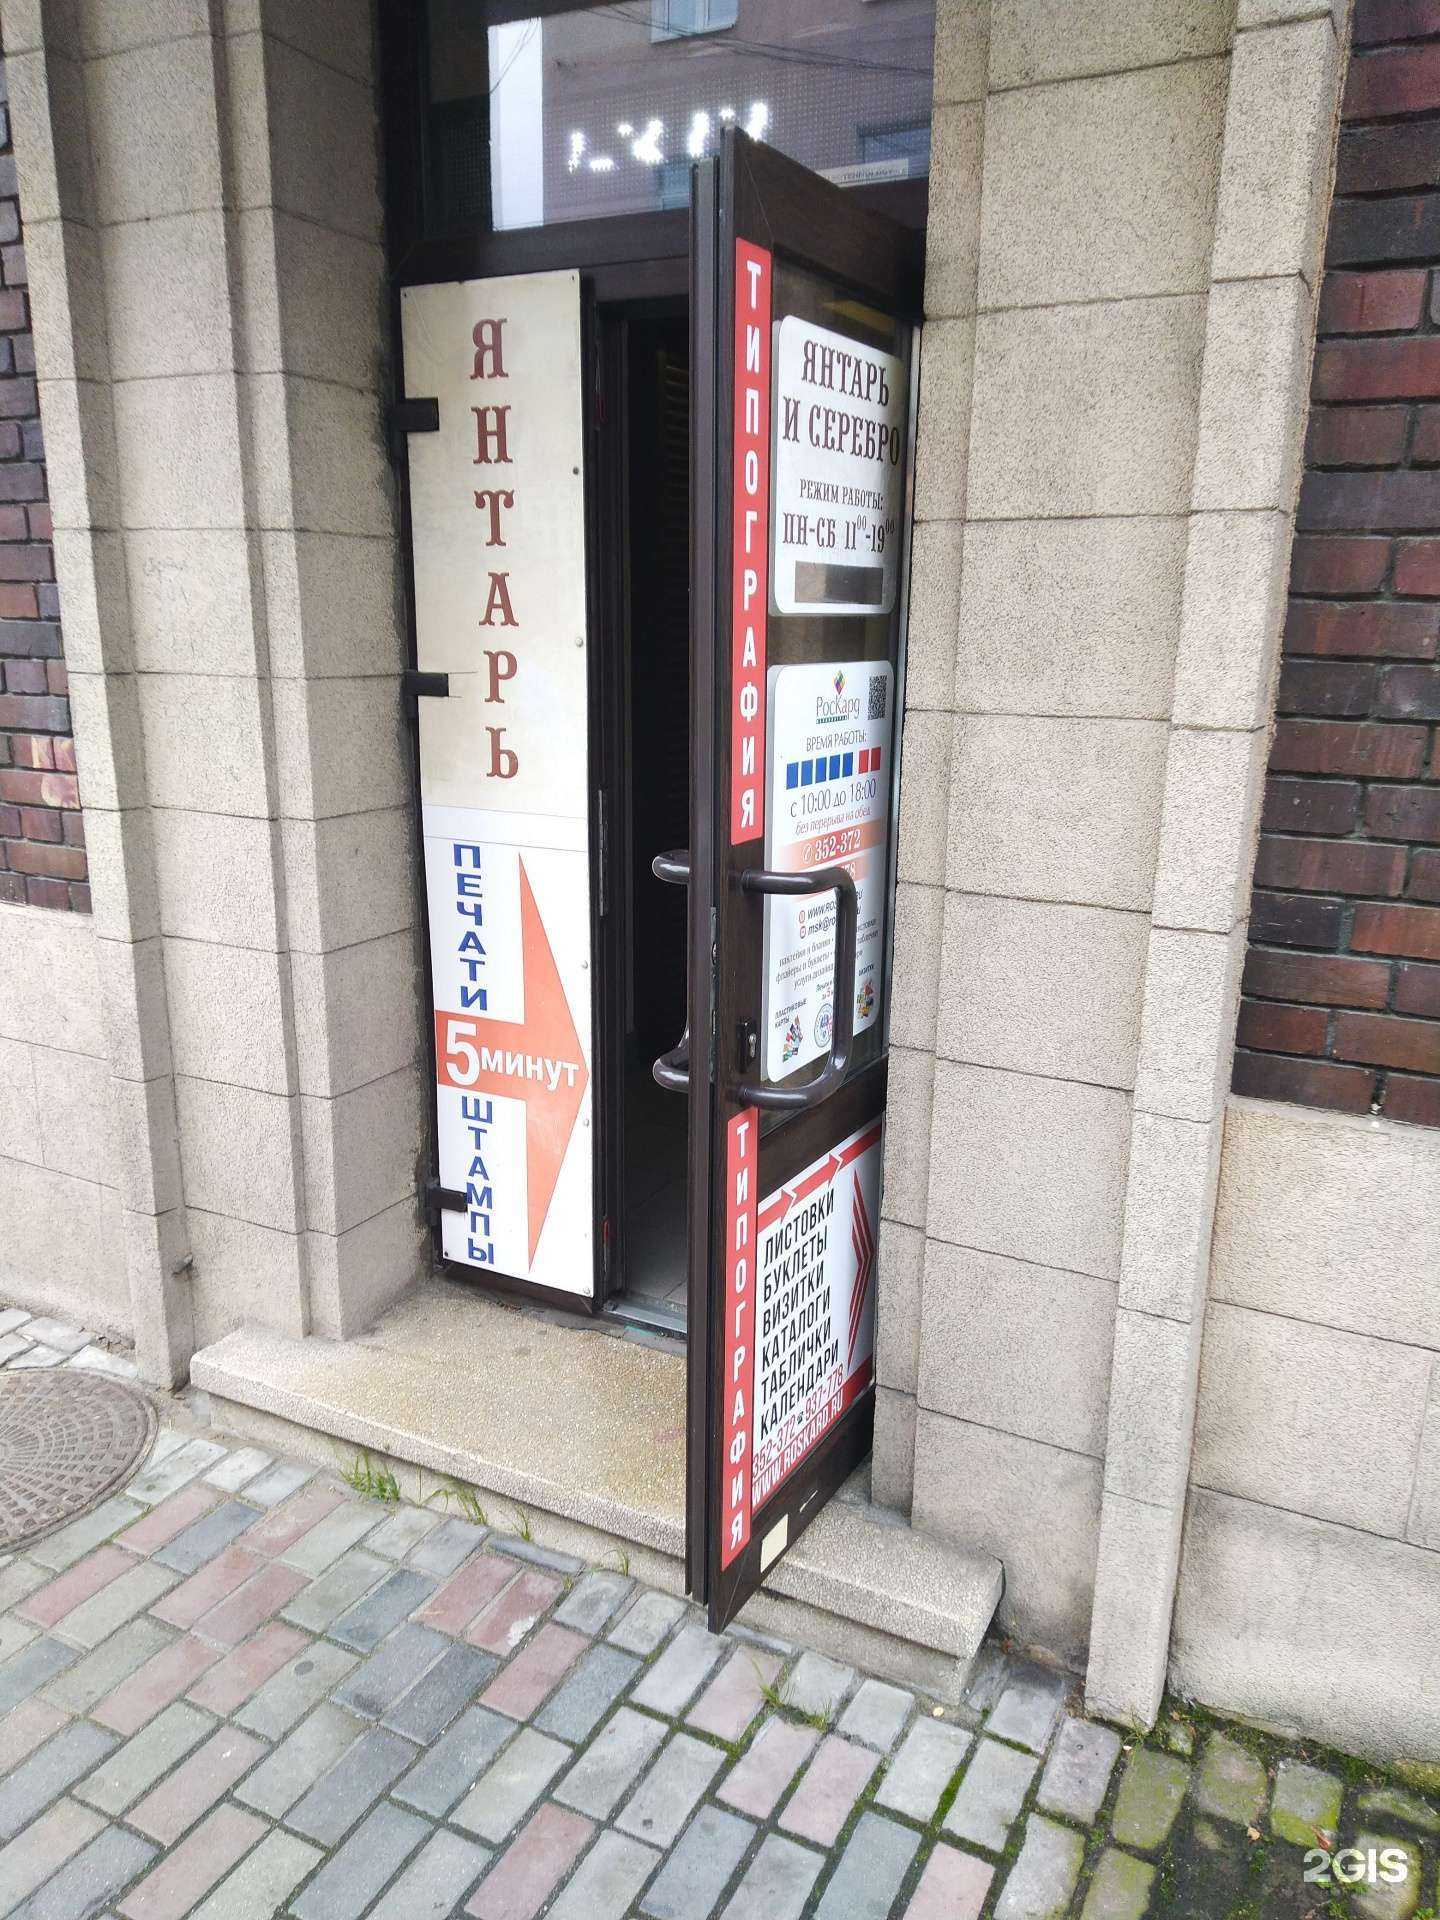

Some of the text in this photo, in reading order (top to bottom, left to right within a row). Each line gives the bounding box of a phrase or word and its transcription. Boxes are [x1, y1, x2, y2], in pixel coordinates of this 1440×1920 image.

[801, 340, 890, 407] ЯНТАРЬ
[782, 395, 901, 466] И СЕРЕБРО
[782, 512, 836, 549] ПН-СБ
[799, 478, 884, 511] РЕЖИМ РАБОТЫ:
[470, 317, 519, 779] ЯНТАРЬ
[740, 260, 761, 829] ТИПОГРАФИЯ
[806, 729, 867, 752] ВРЕМЯ РАБОТЫ:
[801, 788, 831, 815] 10:00
[851, 778, 877, 802] 18:00
[815, 828, 862, 862] 352-372
[453, 842, 489, 1012] ПЕЧАТИ
[445, 1018, 481, 1086] 5
[461, 1094, 495, 1265] ШТАМПЫ
[763, 1224, 828, 1304] БУКЛЕТЫ
[764, 1187, 835, 1270] ЛИСТОВКИ
[729, 1120, 750, 1551] ТИПОГРАФИЯ
[762, 1260, 825, 1339] ВИЗИТКИ
[762, 1285, 831, 1373] КАТАЛОГИ
[760, 1338, 840, 1441] КАЛЕНДАРИ
[761, 1315, 831, 1405] ТАБЛИЧКИ
[752, 1363, 845, 1479] 352-372 937-778
[752, 1388, 844, 1507] WWW.ROSKARD.RU
